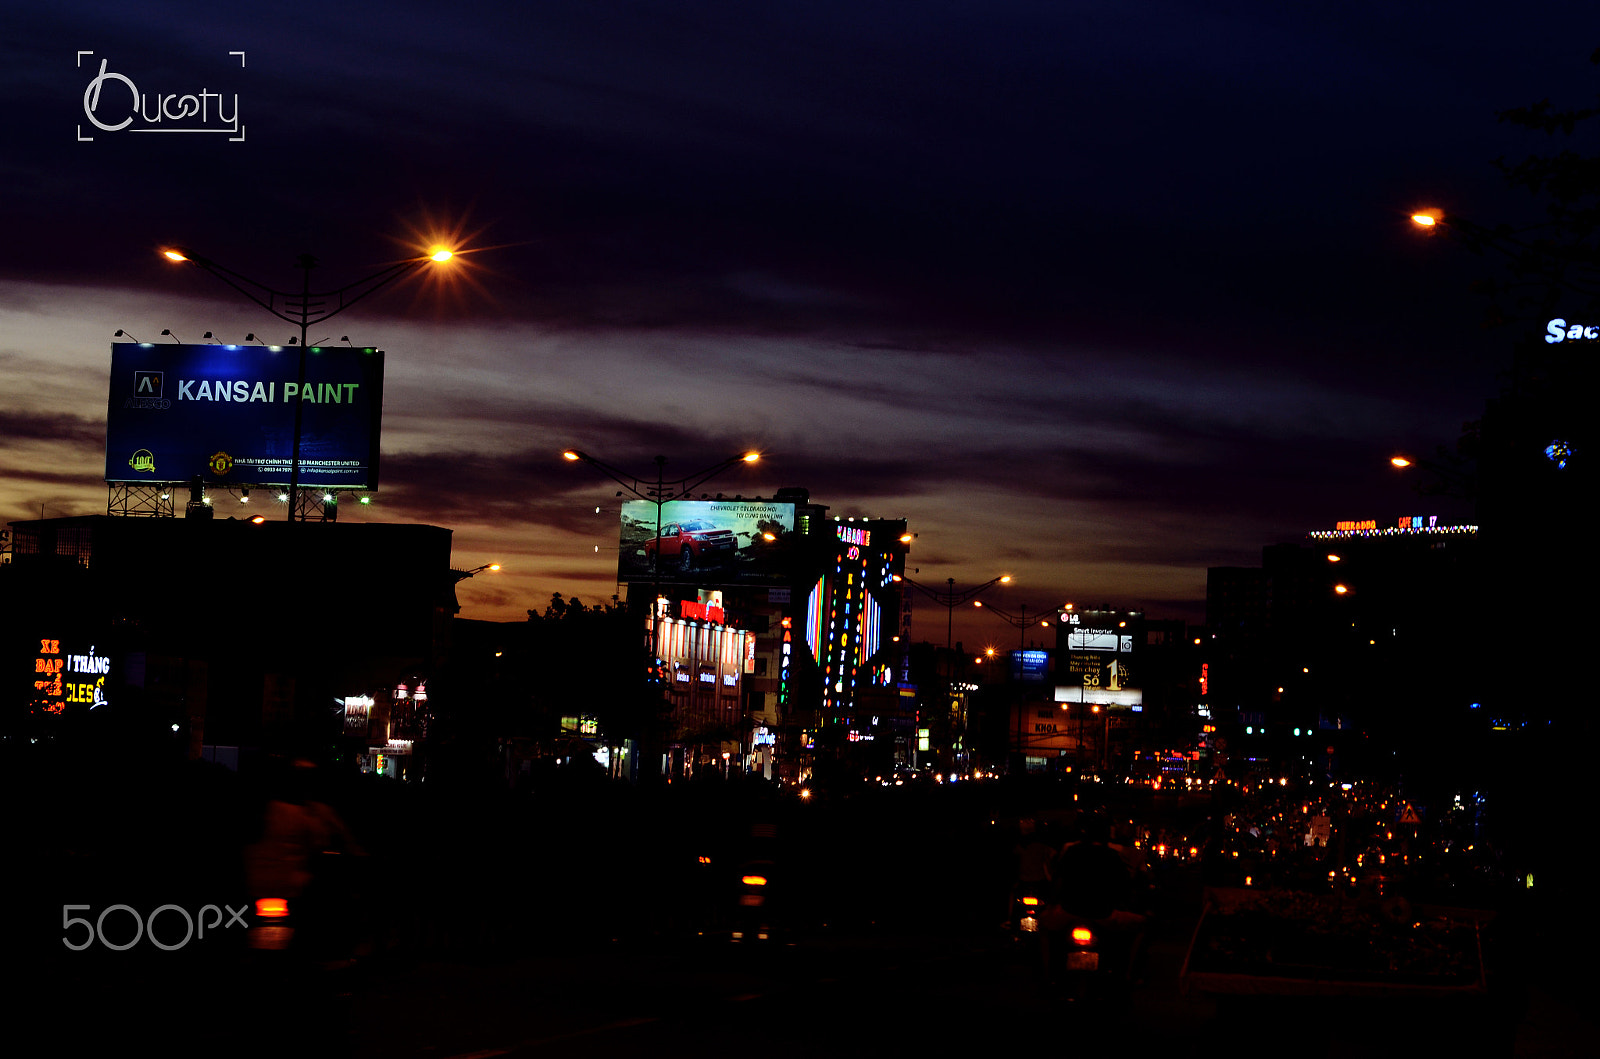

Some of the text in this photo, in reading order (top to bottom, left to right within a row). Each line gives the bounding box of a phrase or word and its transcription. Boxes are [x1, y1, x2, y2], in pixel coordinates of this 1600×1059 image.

[178, 380, 359, 404] KANSAI PAINT
[836, 525, 871, 547] KARAOKE
[1069, 613, 1079, 622] LG
[40, 639, 60, 654] XE
[35, 658, 64, 677] ĐẠP
[1105, 659, 1122, 691] 1
